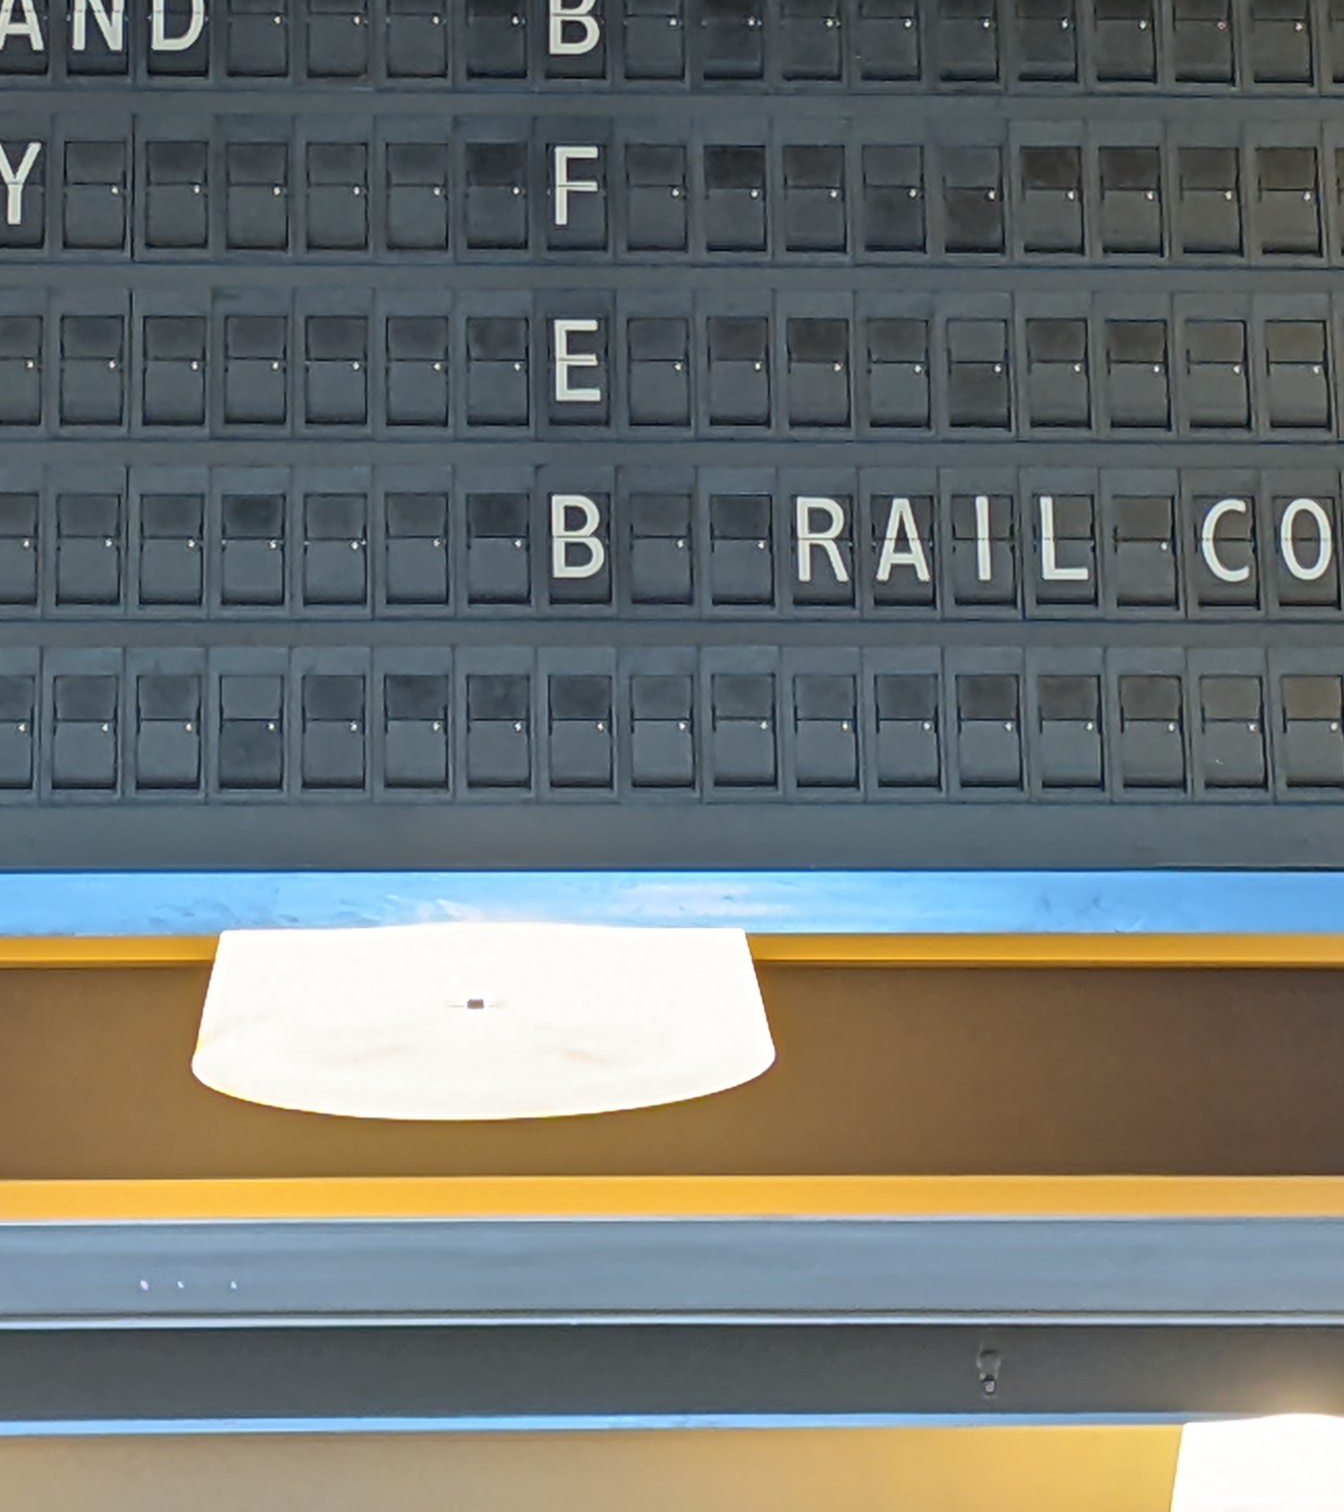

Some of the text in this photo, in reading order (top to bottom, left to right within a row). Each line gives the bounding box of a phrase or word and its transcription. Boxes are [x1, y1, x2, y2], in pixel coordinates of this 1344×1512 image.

[553, 145, 599, 226] F
[553, 318, 602, 403] E
[550, 493, 606, 579] B
[795, 494, 1090, 583] RAIL
